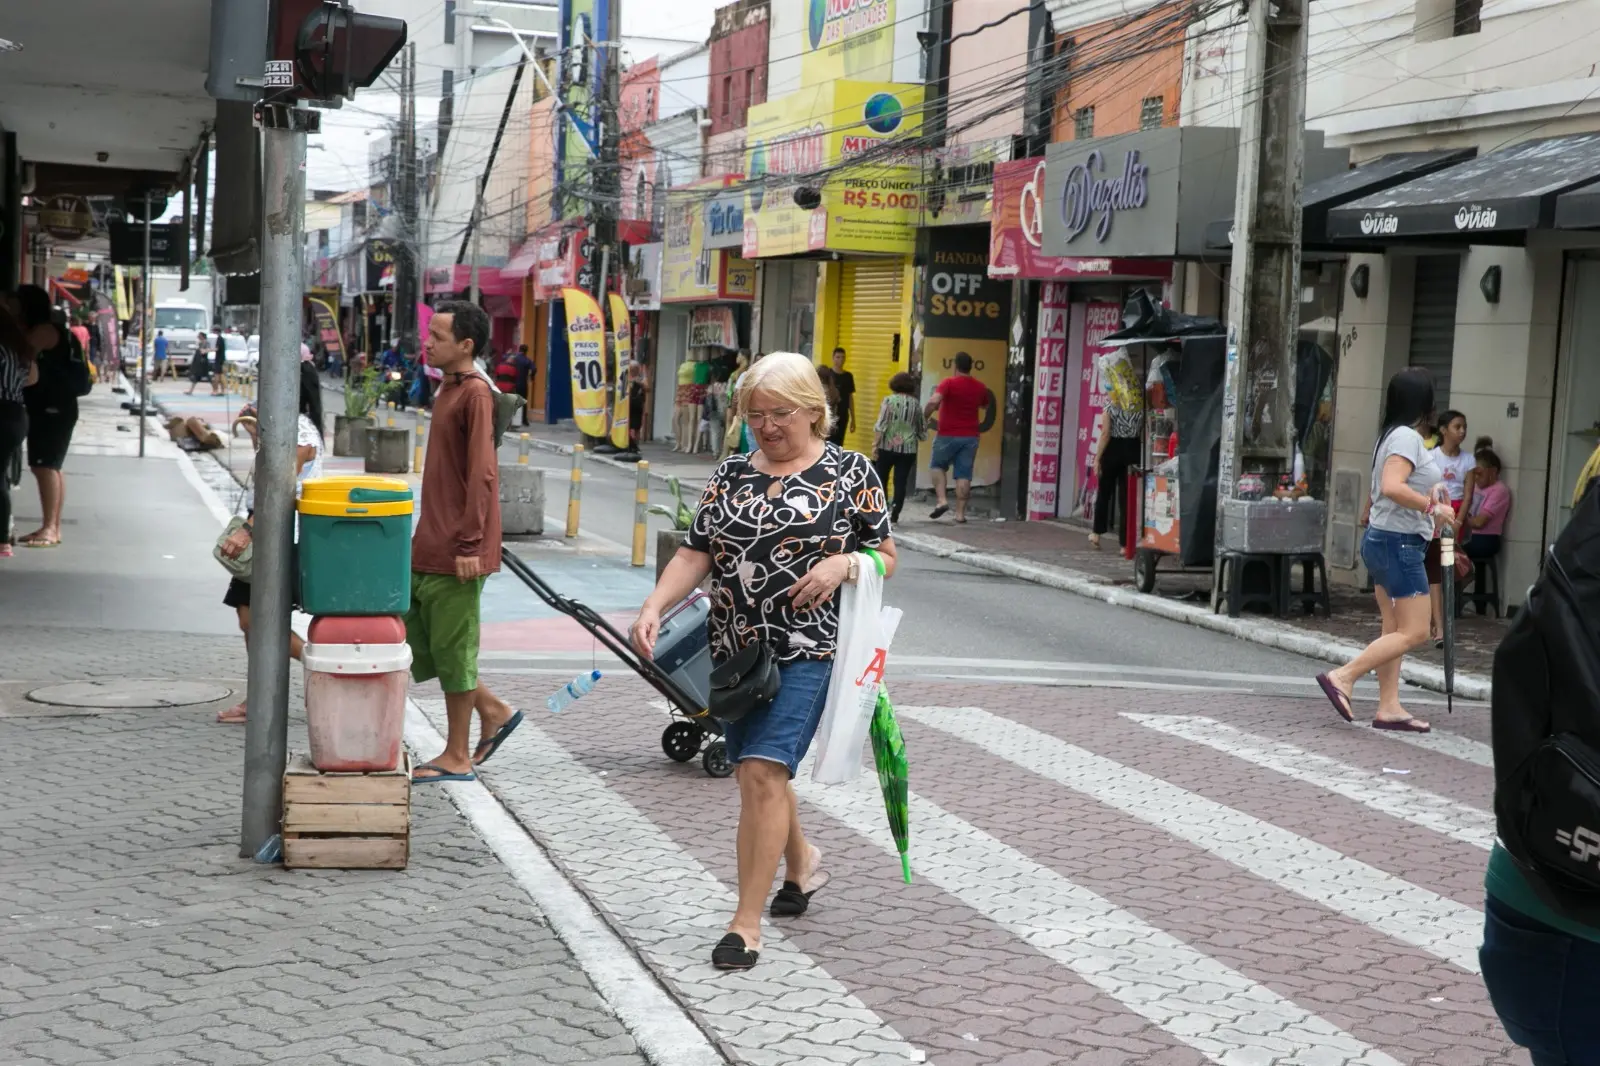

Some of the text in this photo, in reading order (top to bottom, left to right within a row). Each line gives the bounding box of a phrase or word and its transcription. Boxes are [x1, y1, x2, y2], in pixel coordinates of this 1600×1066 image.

[844, 179, 878, 191] PREÇO
[843, 190, 867, 208] R$
[735, 274, 746, 286] 20
[931, 272, 983, 295] OFF
[930, 294, 1001, 318] Store
[570, 322, 601, 332] Graça
[1009, 346, 1025, 365] 734
[574, 360, 602, 390] 10
